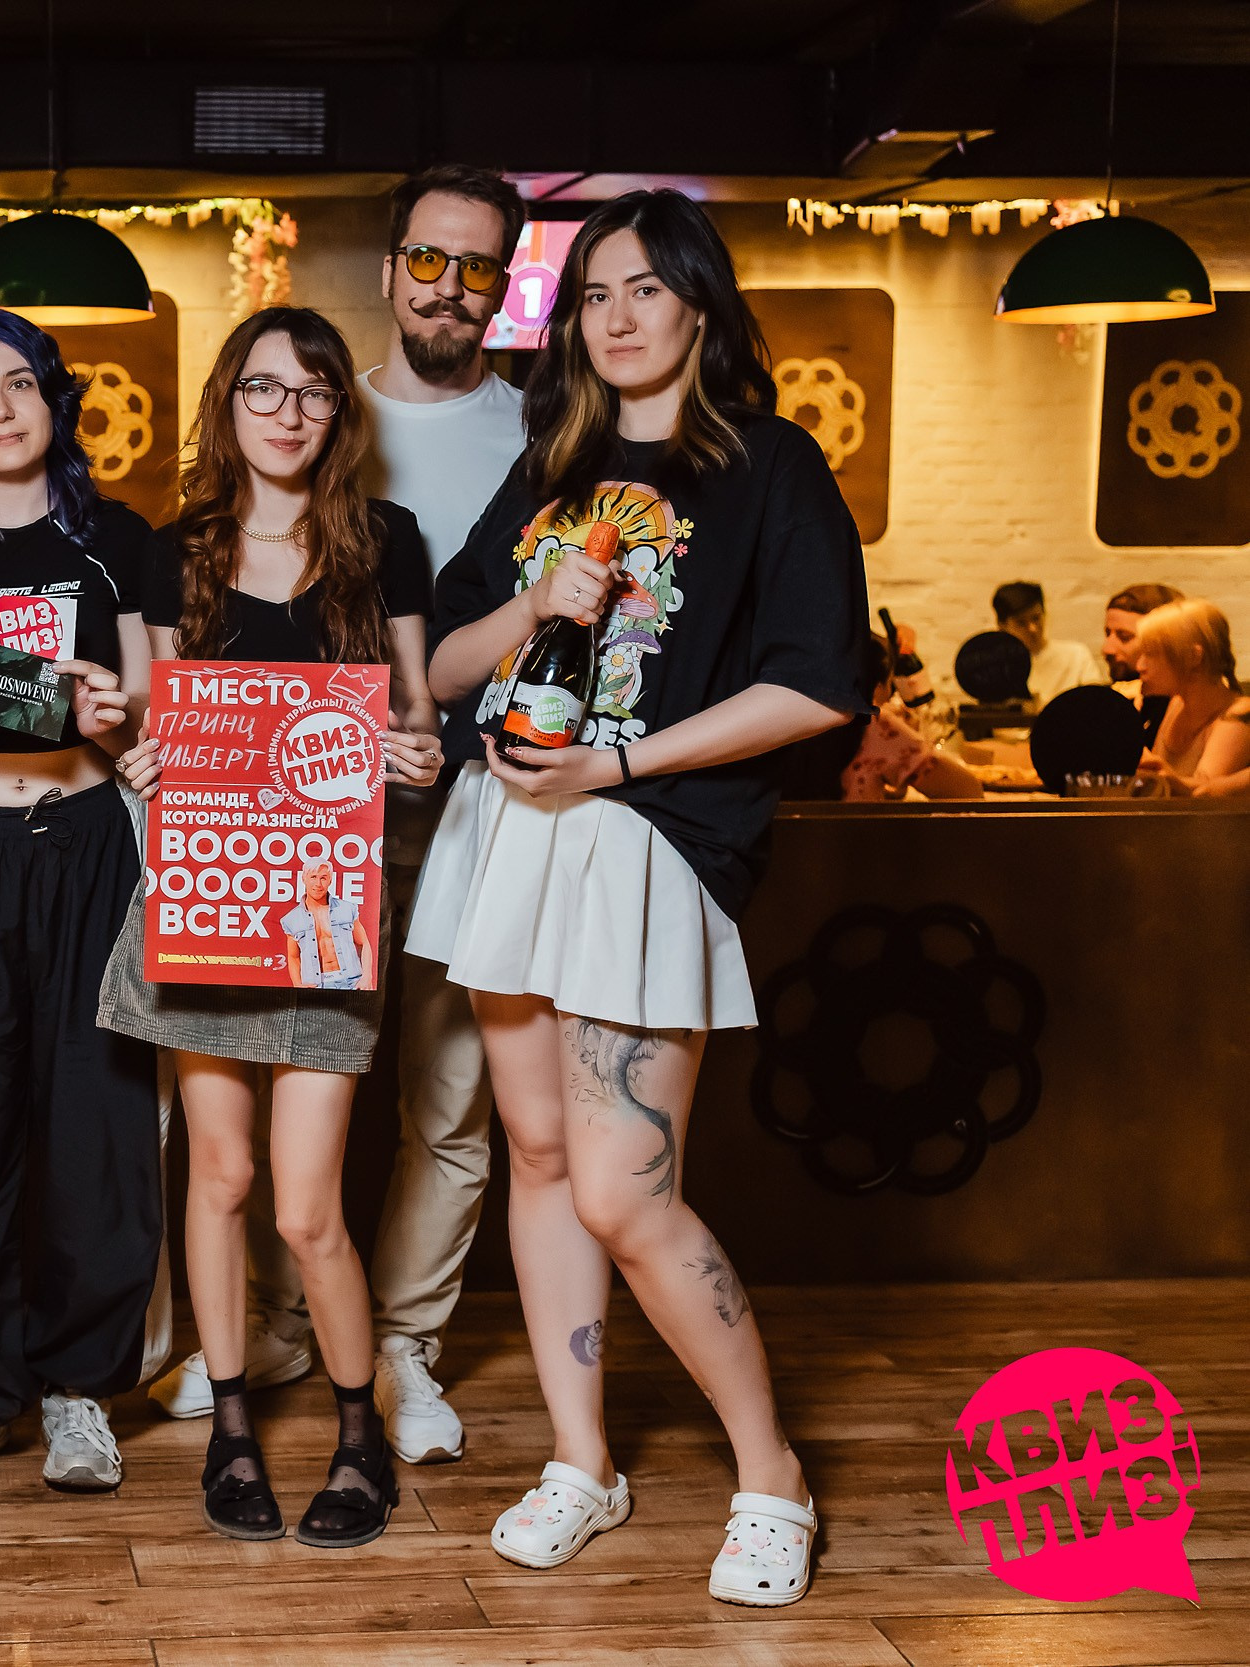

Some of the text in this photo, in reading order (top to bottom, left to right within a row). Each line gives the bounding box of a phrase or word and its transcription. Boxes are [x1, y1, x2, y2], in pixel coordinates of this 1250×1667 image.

[518, 277, 543, 319] 1
[167, 677, 311, 705] 1 МЕСТО
[157, 710, 256, 742] ПРИНЦ
[158, 742, 266, 771] АЛЬБЕРТ
[162, 791, 254, 809] КОМАНДЕ,
[161, 811, 338, 829] КОТОРАЯ РАЗНЕСЛА
[158, 903, 271, 938] ВСЕХ
